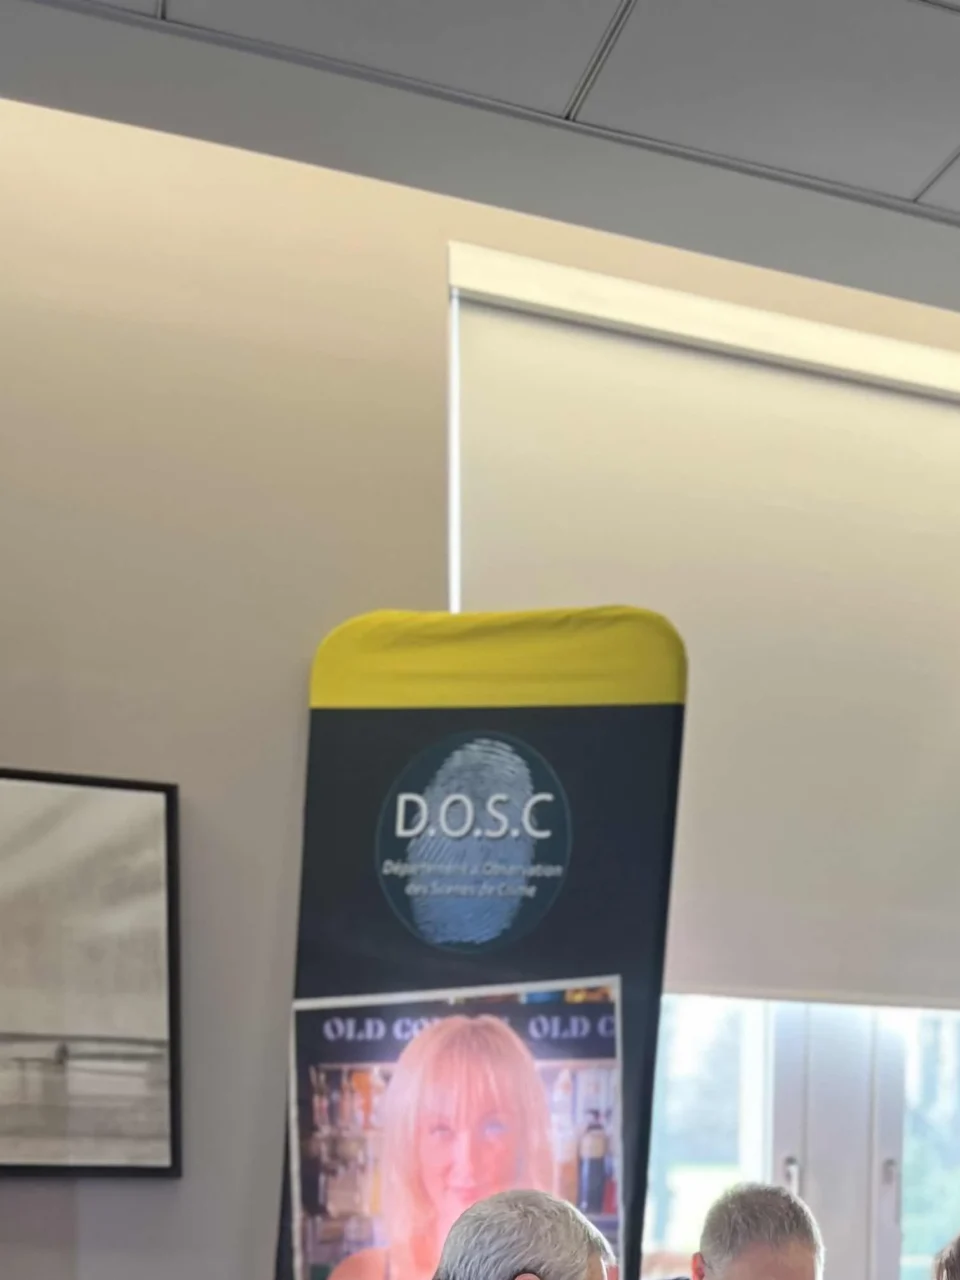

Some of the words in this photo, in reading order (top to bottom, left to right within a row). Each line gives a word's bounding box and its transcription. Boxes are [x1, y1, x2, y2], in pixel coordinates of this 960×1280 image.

[395, 792, 555, 839] D.O.S.C
[323, 1016, 386, 1041] OLD
[528, 1014, 591, 1039] OLD
